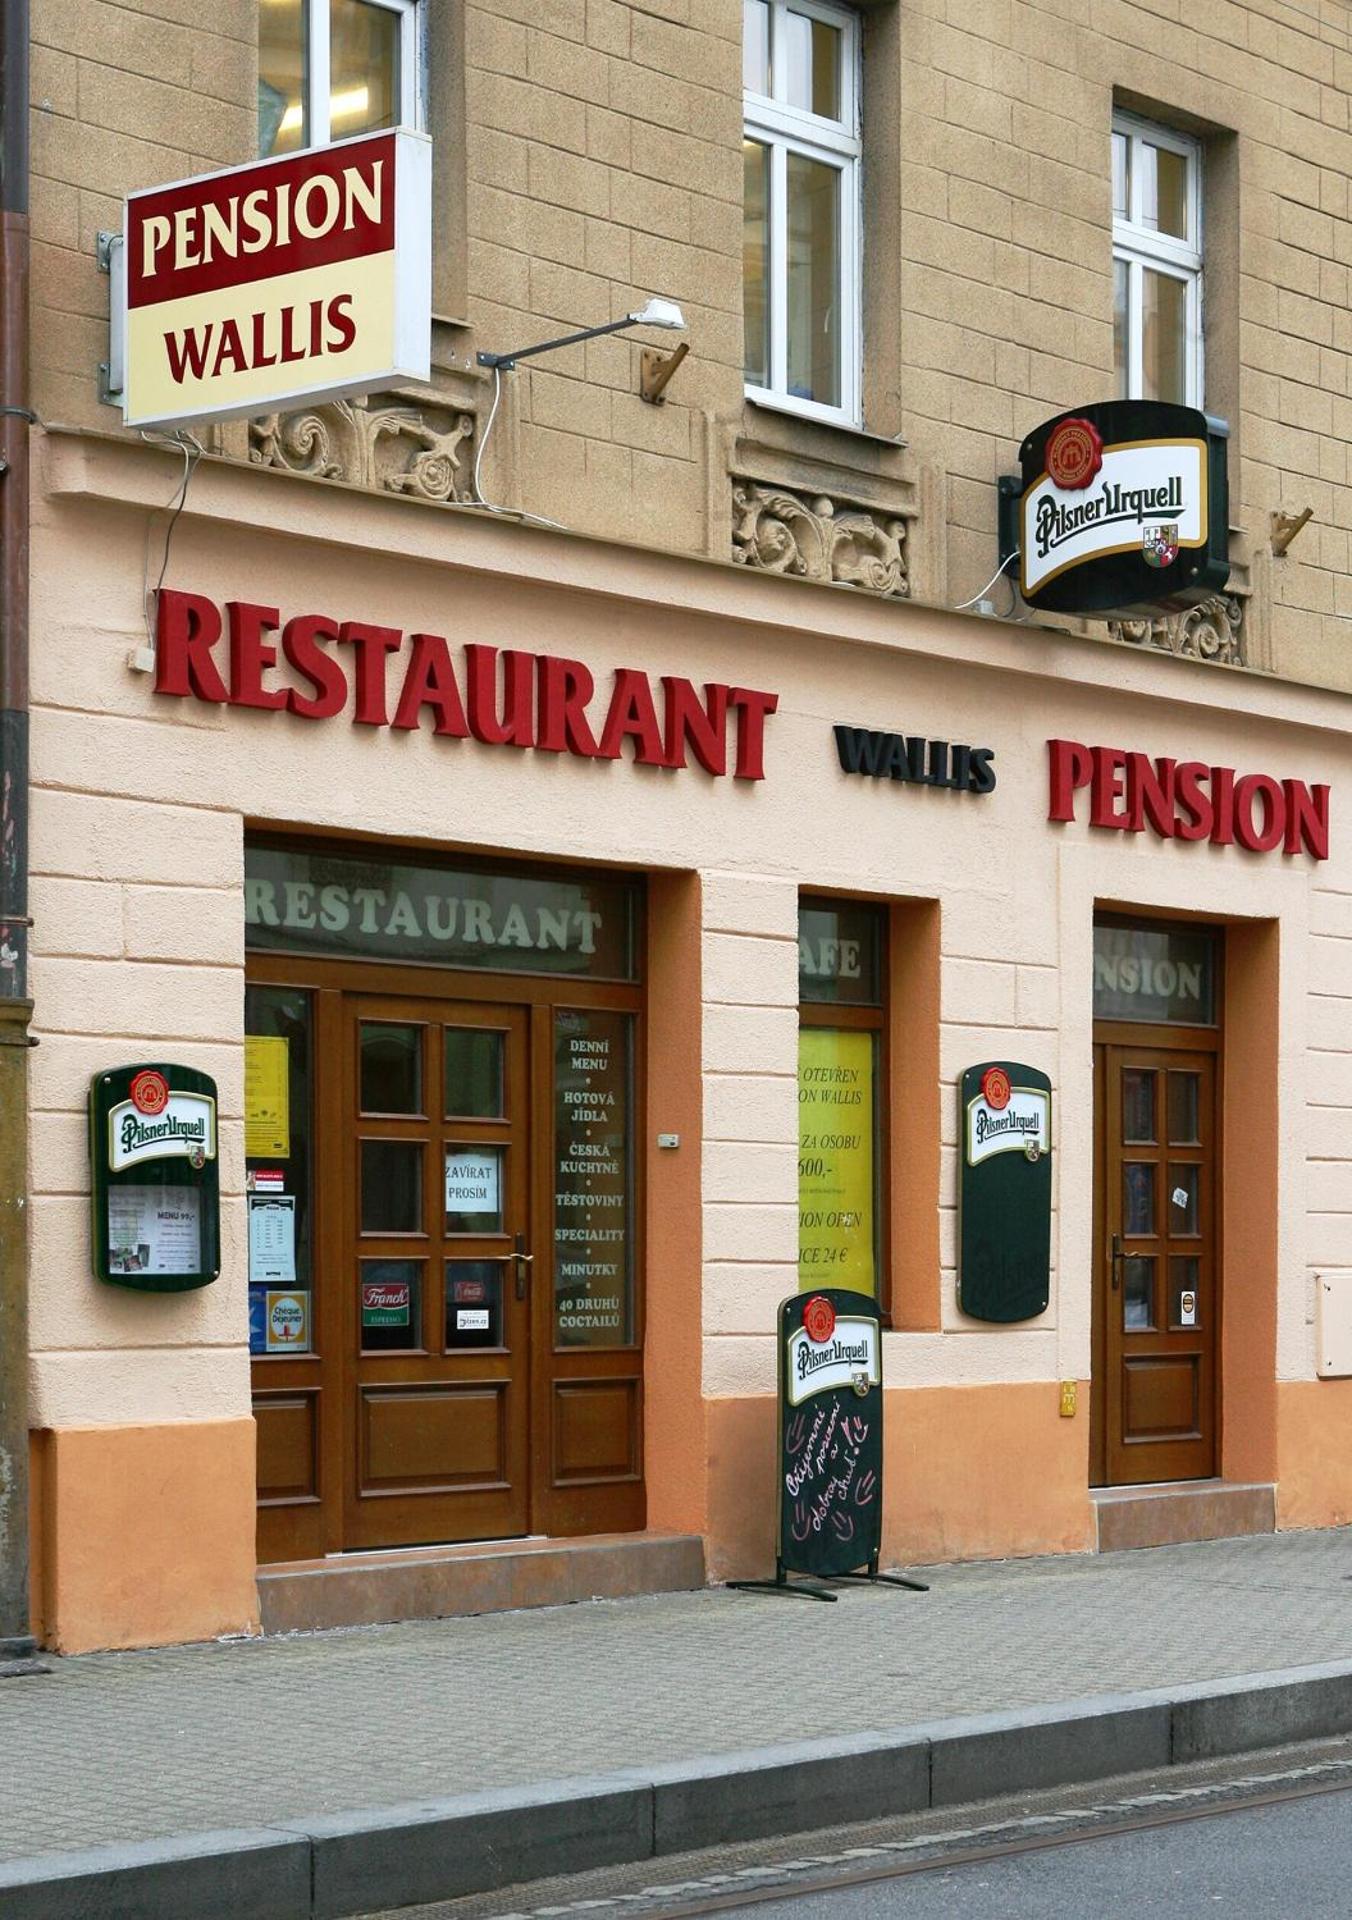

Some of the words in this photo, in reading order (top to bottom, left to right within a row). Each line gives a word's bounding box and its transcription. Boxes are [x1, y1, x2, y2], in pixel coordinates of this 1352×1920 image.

[141, 160, 384, 278] PENSION
[163, 294, 357, 385] WALLIS
[1035, 494, 1105, 559] Pilsner
[1102, 476, 1182, 525] Urquell
[152, 588, 779, 781] RESTAURANT
[833, 725, 997, 794] WALLIS
[1046, 739, 1331, 861] PENSION
[244, 878, 603, 954] RESTAURANT
[570, 1040, 609, 1054] DENNÍ
[571, 1057, 608, 1071] MENU
[564, 1090, 615, 1106] HOTOVÁ
[820, 1088, 863, 1105] WALLIS
[571, 1106, 608, 1121] JÍDLA
[121, 1113, 168, 1154] Pilsner
[167, 1113, 205, 1143] Urquell
[976, 1108, 1010, 1144] Pilsner
[1008, 1110, 1040, 1135] Urquell
[569, 1141, 610, 1157] ČESKÁ
[801, 1134, 817, 1149] ZA
[820, 1134, 862, 1150] OSOBU
[448, 1184, 488, 1199] PROSÍM
[157, 1211, 180, 1220] MENU
[826, 1211, 863, 1228] OPEN
[555, 1228, 625, 1241] SPECIALITY
[823, 1247, 837, 1264] 24
[840, 1247, 848, 1263] €
[561, 1263, 618, 1276] MINUTKY
[560, 1300, 573, 1312] 40
[797, 1340, 834, 1381] Pilsner
[832, 1339, 868, 1368] Urquell
